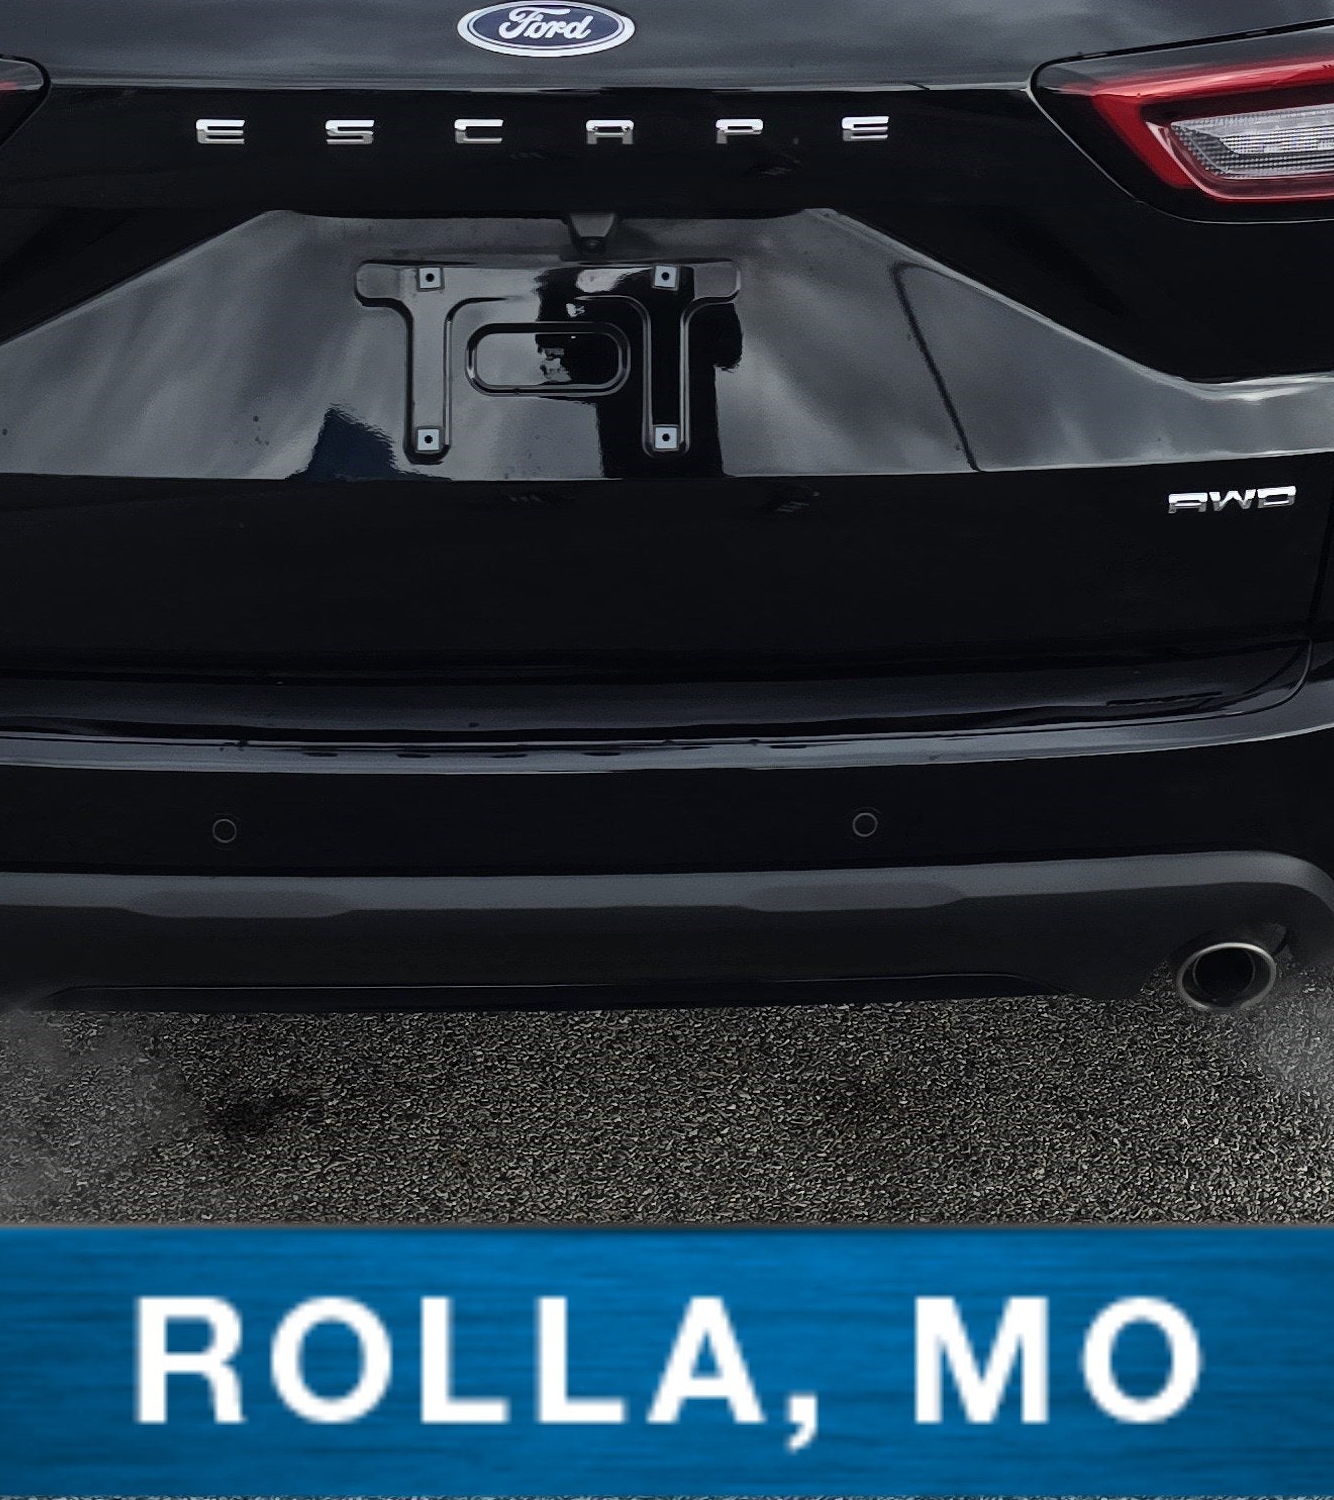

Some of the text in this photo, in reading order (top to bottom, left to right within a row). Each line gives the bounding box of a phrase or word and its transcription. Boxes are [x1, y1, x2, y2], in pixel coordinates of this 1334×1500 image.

[498, 6, 594, 40] Ford
[195, 114, 890, 146] ESCAPE
[1167, 485, 1297, 514] AWD
